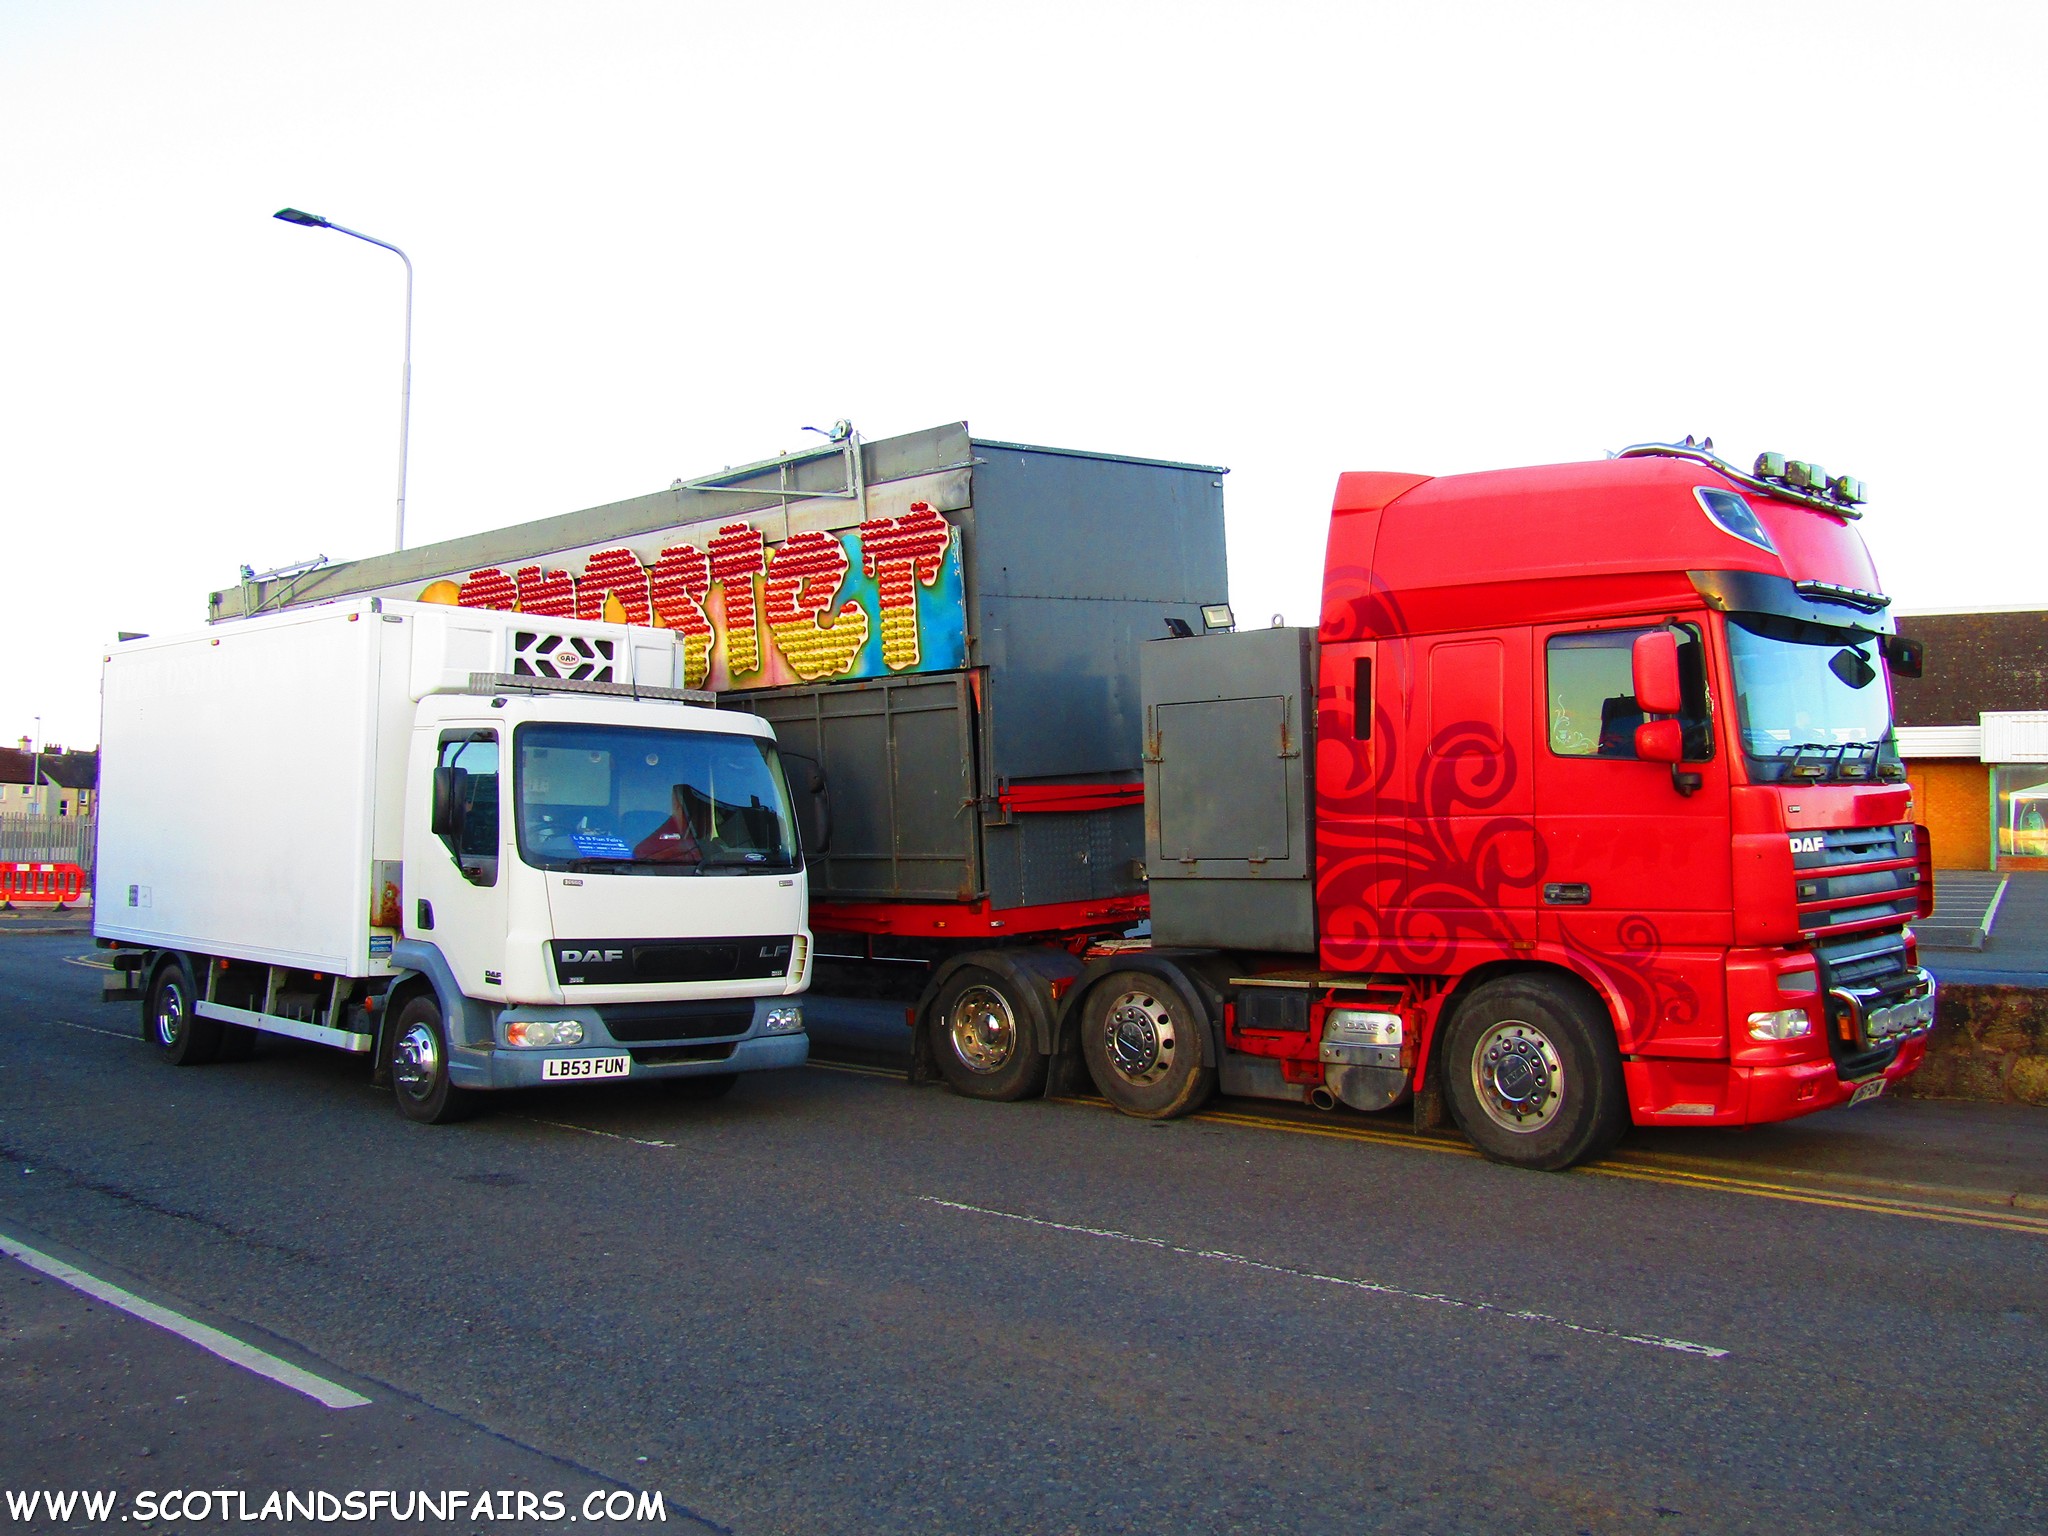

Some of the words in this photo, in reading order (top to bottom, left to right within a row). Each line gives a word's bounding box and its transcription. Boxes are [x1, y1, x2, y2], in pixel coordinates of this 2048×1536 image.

[1789, 837, 1824, 853] DAF
[561, 950, 623, 962] DAF
[759, 945, 789, 958] LF
[485, 970, 502, 978] DAF
[549, 1060, 591, 1076] LB53
[595, 1058, 624, 1074] FUN
